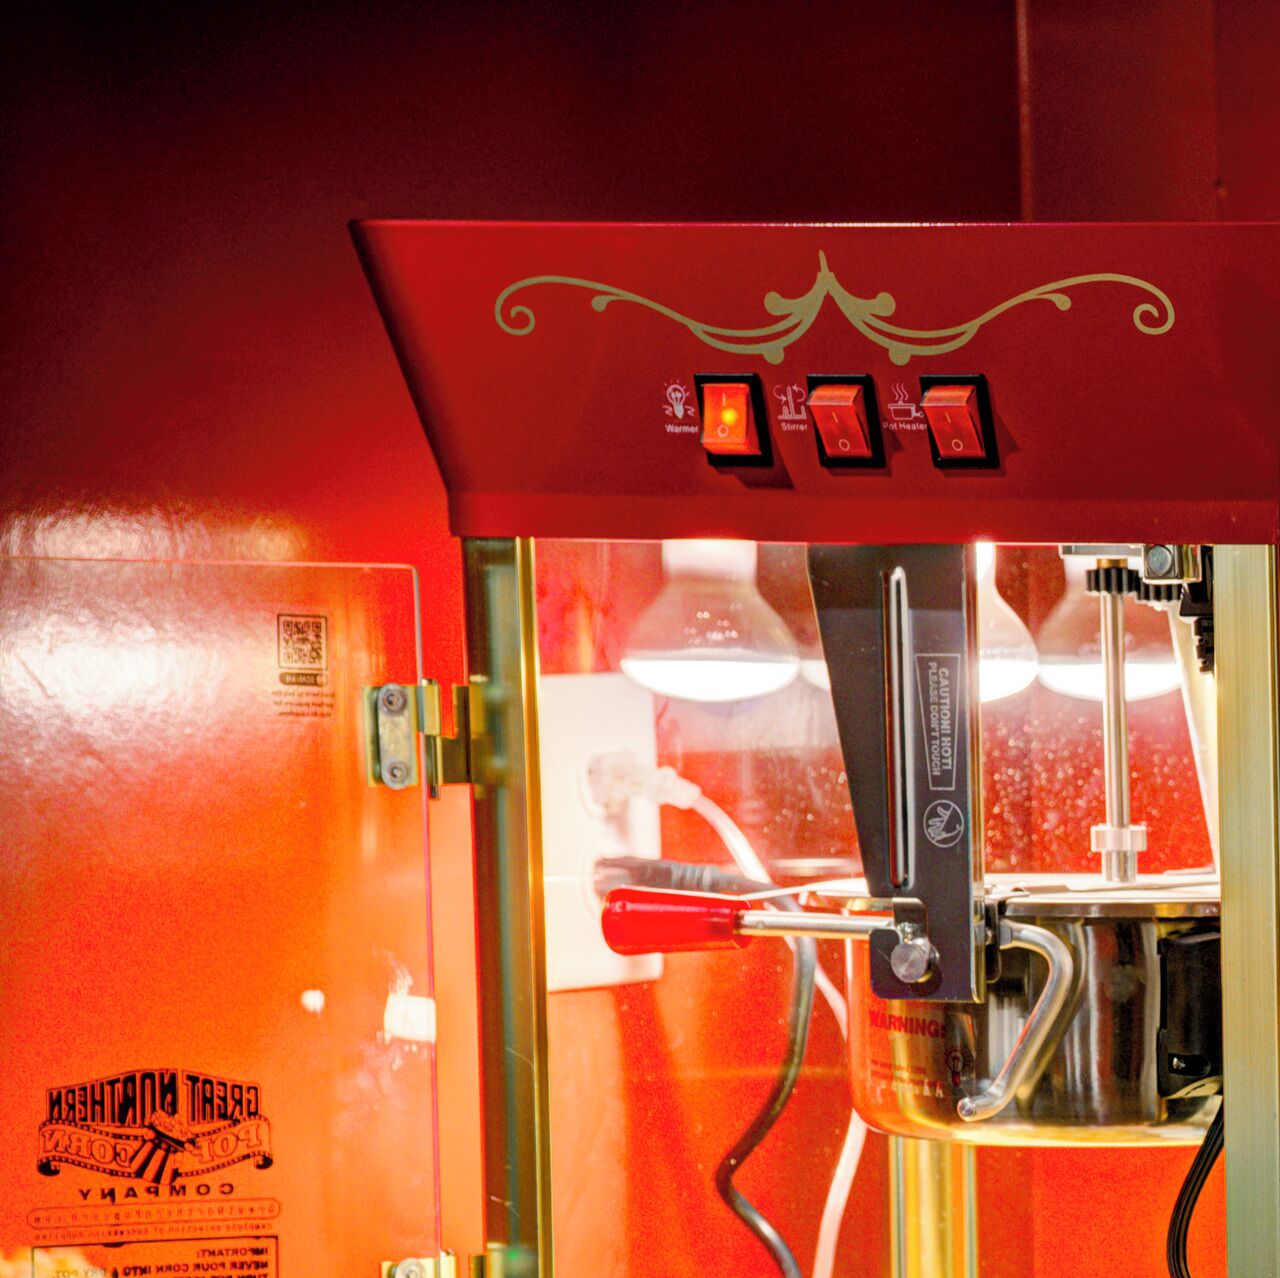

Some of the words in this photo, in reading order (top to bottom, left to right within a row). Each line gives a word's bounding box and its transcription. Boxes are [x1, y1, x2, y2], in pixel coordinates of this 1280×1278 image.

[664, 424, 699, 434] Warmer
[780, 422, 808, 431] Stirrer
[882, 421, 898, 430] Pot
[899, 421, 928, 430] Heater
[928, 661, 938, 704] PLEASE
[930, 704, 940, 737] DON'T
[931, 738, 941, 776] TOUCH
[869, 1009, 946, 1039] WARNING:
